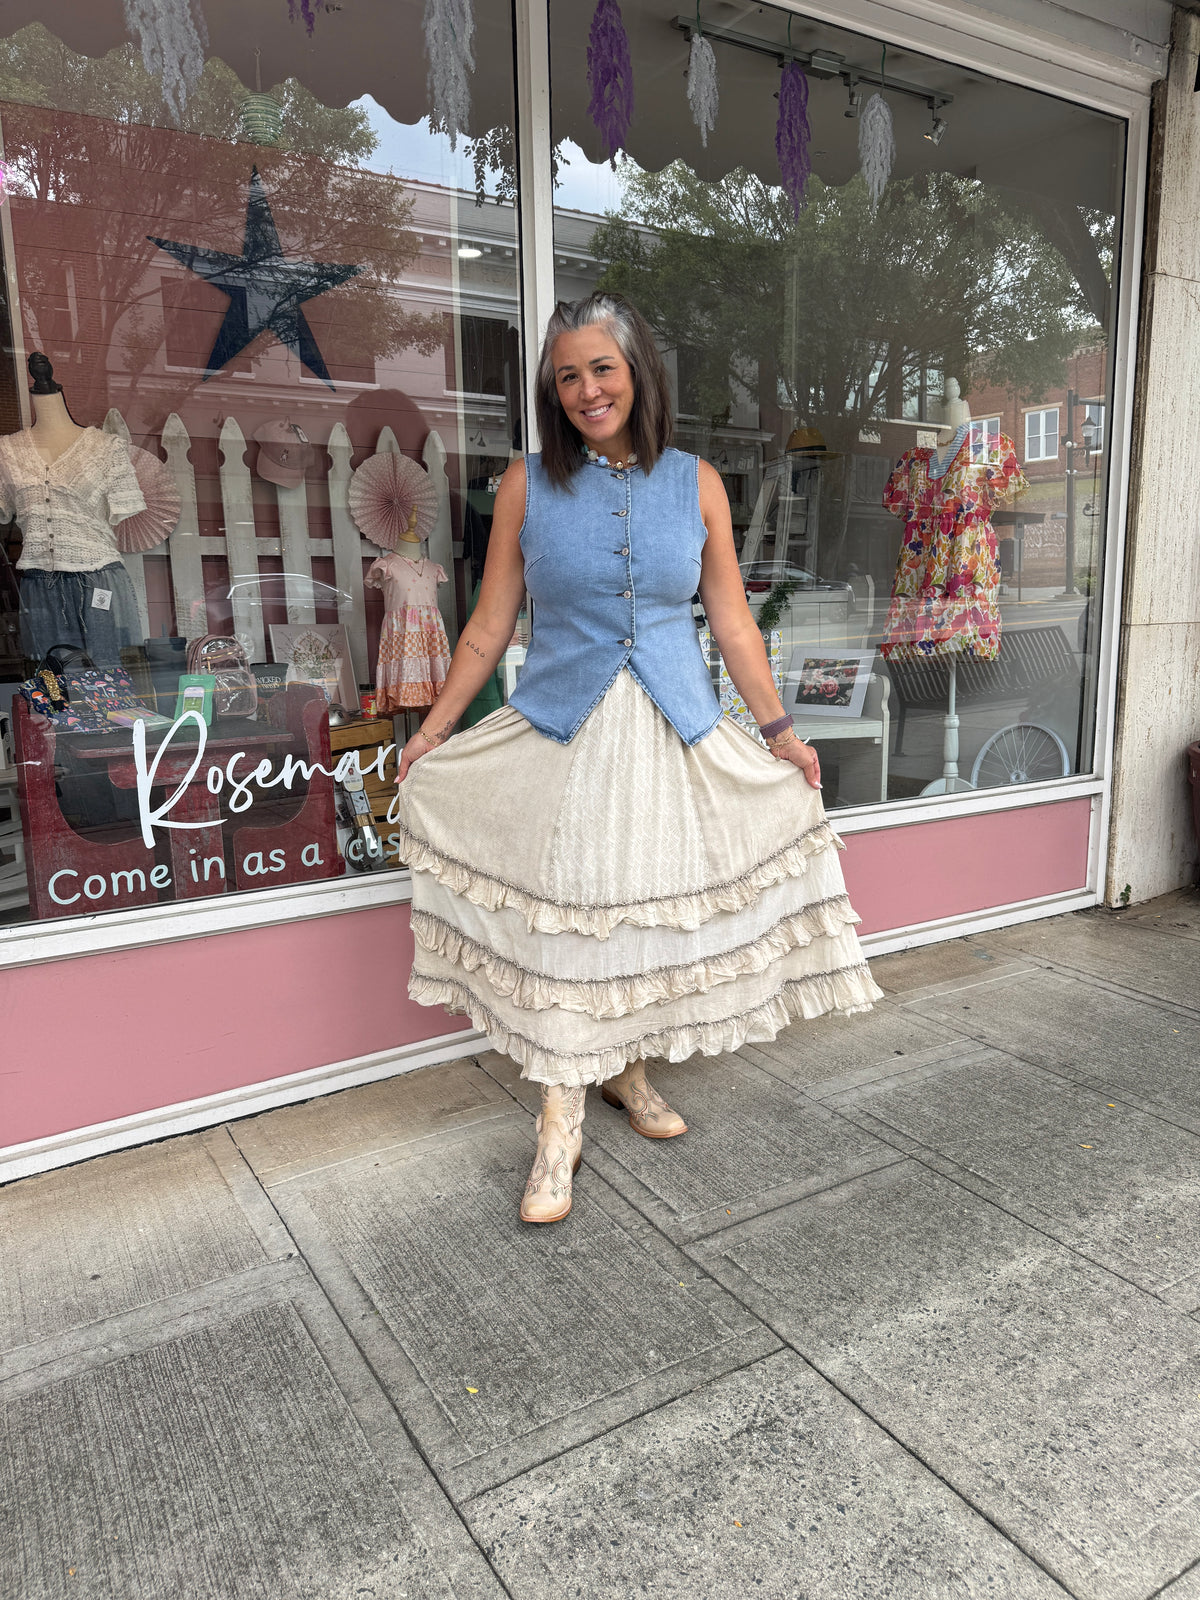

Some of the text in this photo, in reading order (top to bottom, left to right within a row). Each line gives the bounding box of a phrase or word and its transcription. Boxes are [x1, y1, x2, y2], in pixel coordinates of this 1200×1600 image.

[48, 833, 401, 905] Come in as a cus
